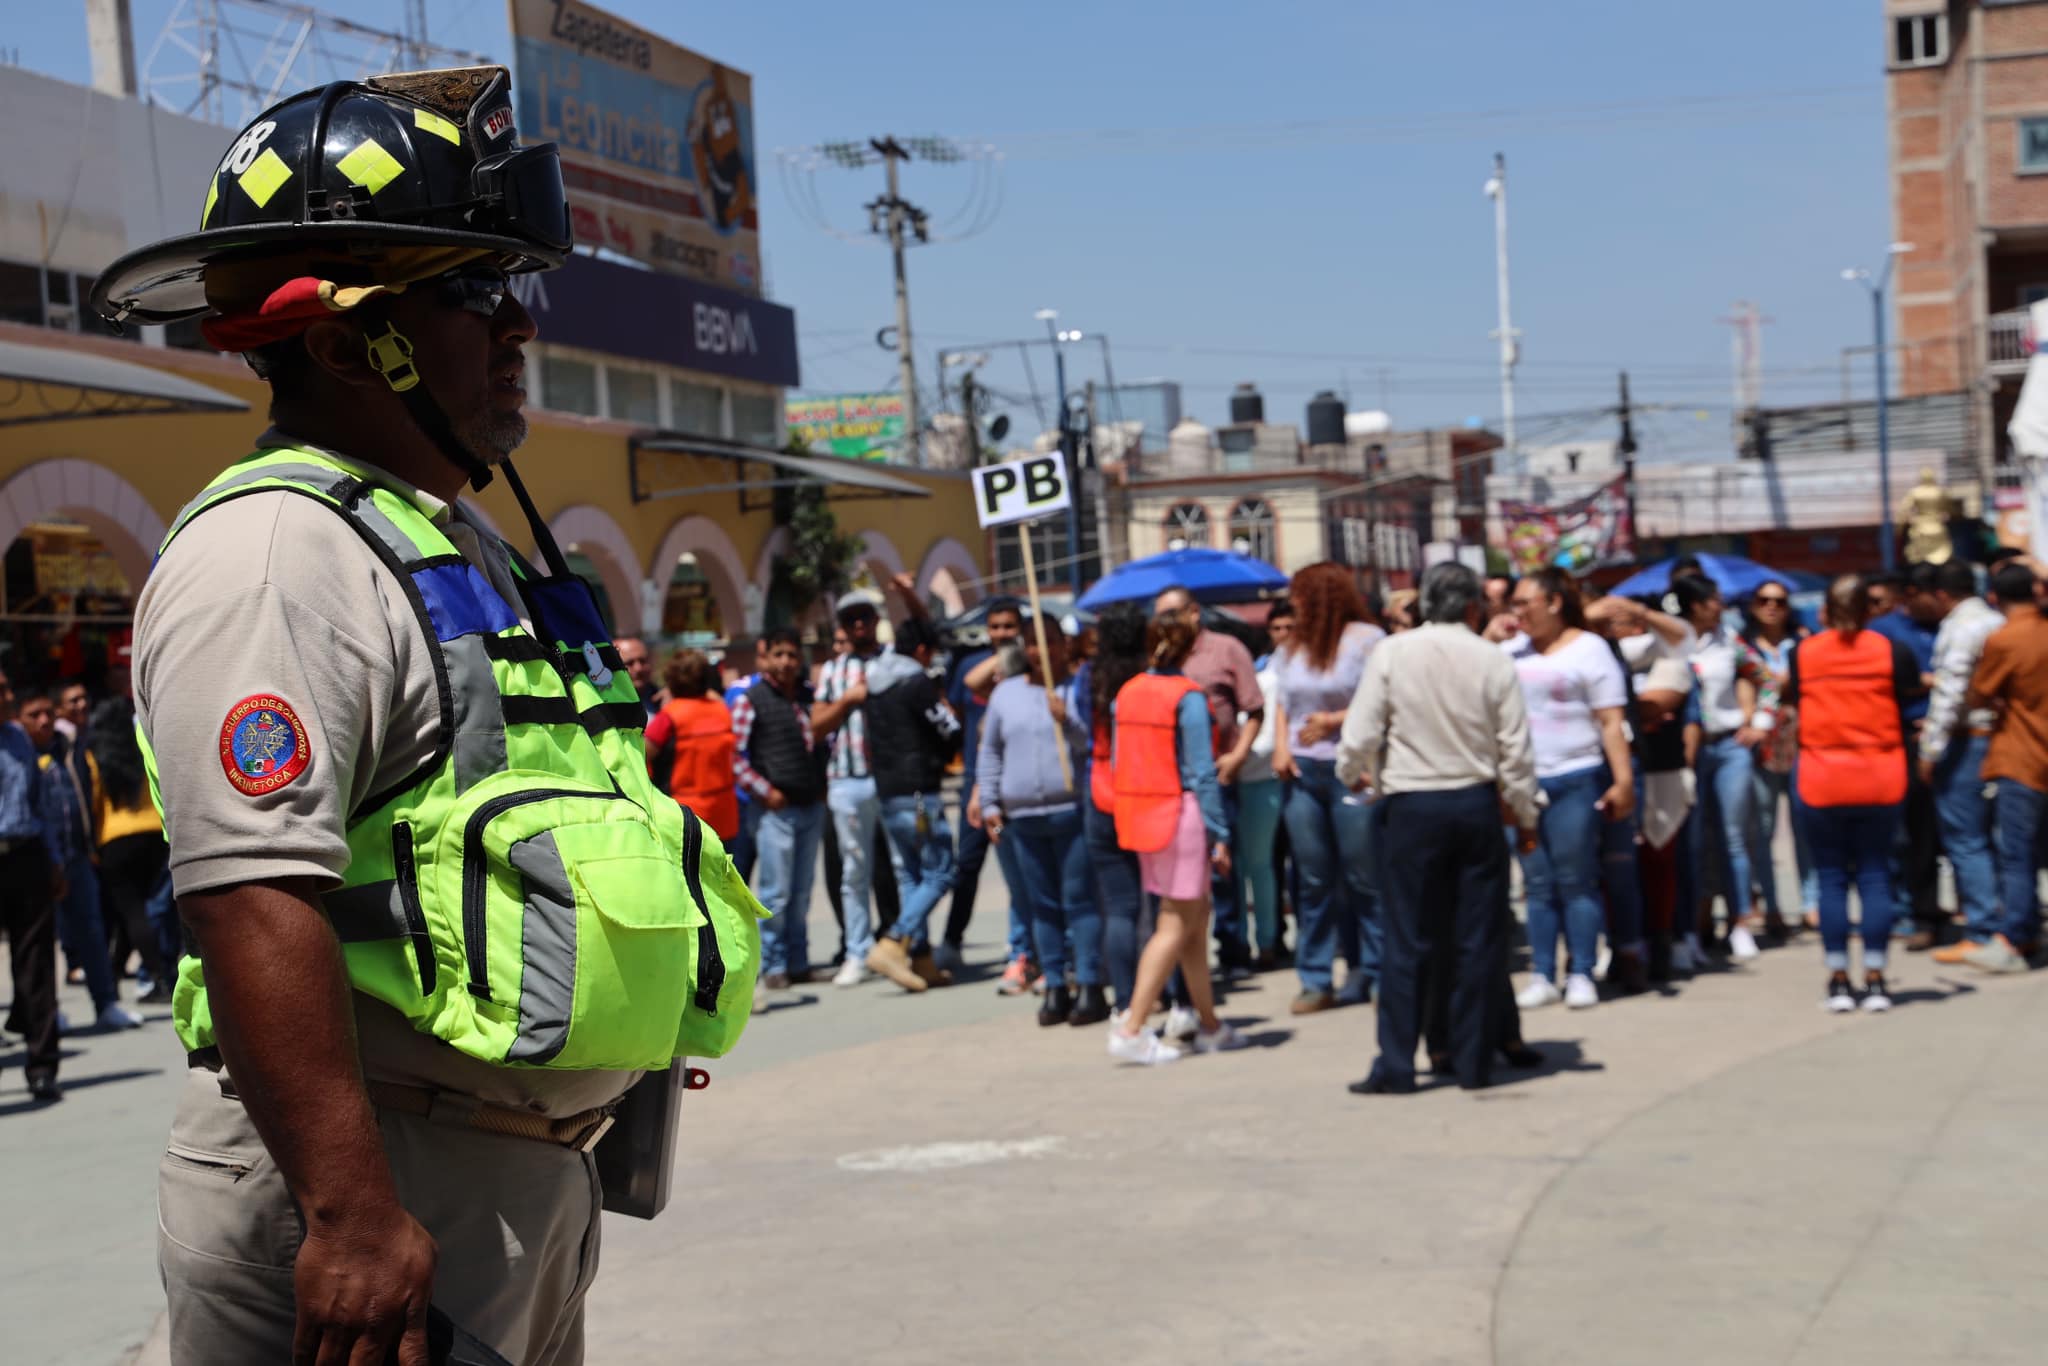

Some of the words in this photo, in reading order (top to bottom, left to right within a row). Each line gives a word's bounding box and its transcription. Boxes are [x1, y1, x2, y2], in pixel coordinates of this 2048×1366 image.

[539, 70, 680, 172] Leoncita
[693, 303, 758, 355] BBVA
[982, 458, 1064, 514] PB
[225, 700, 259, 733] CUERPO
[260, 698, 276, 708] DE
